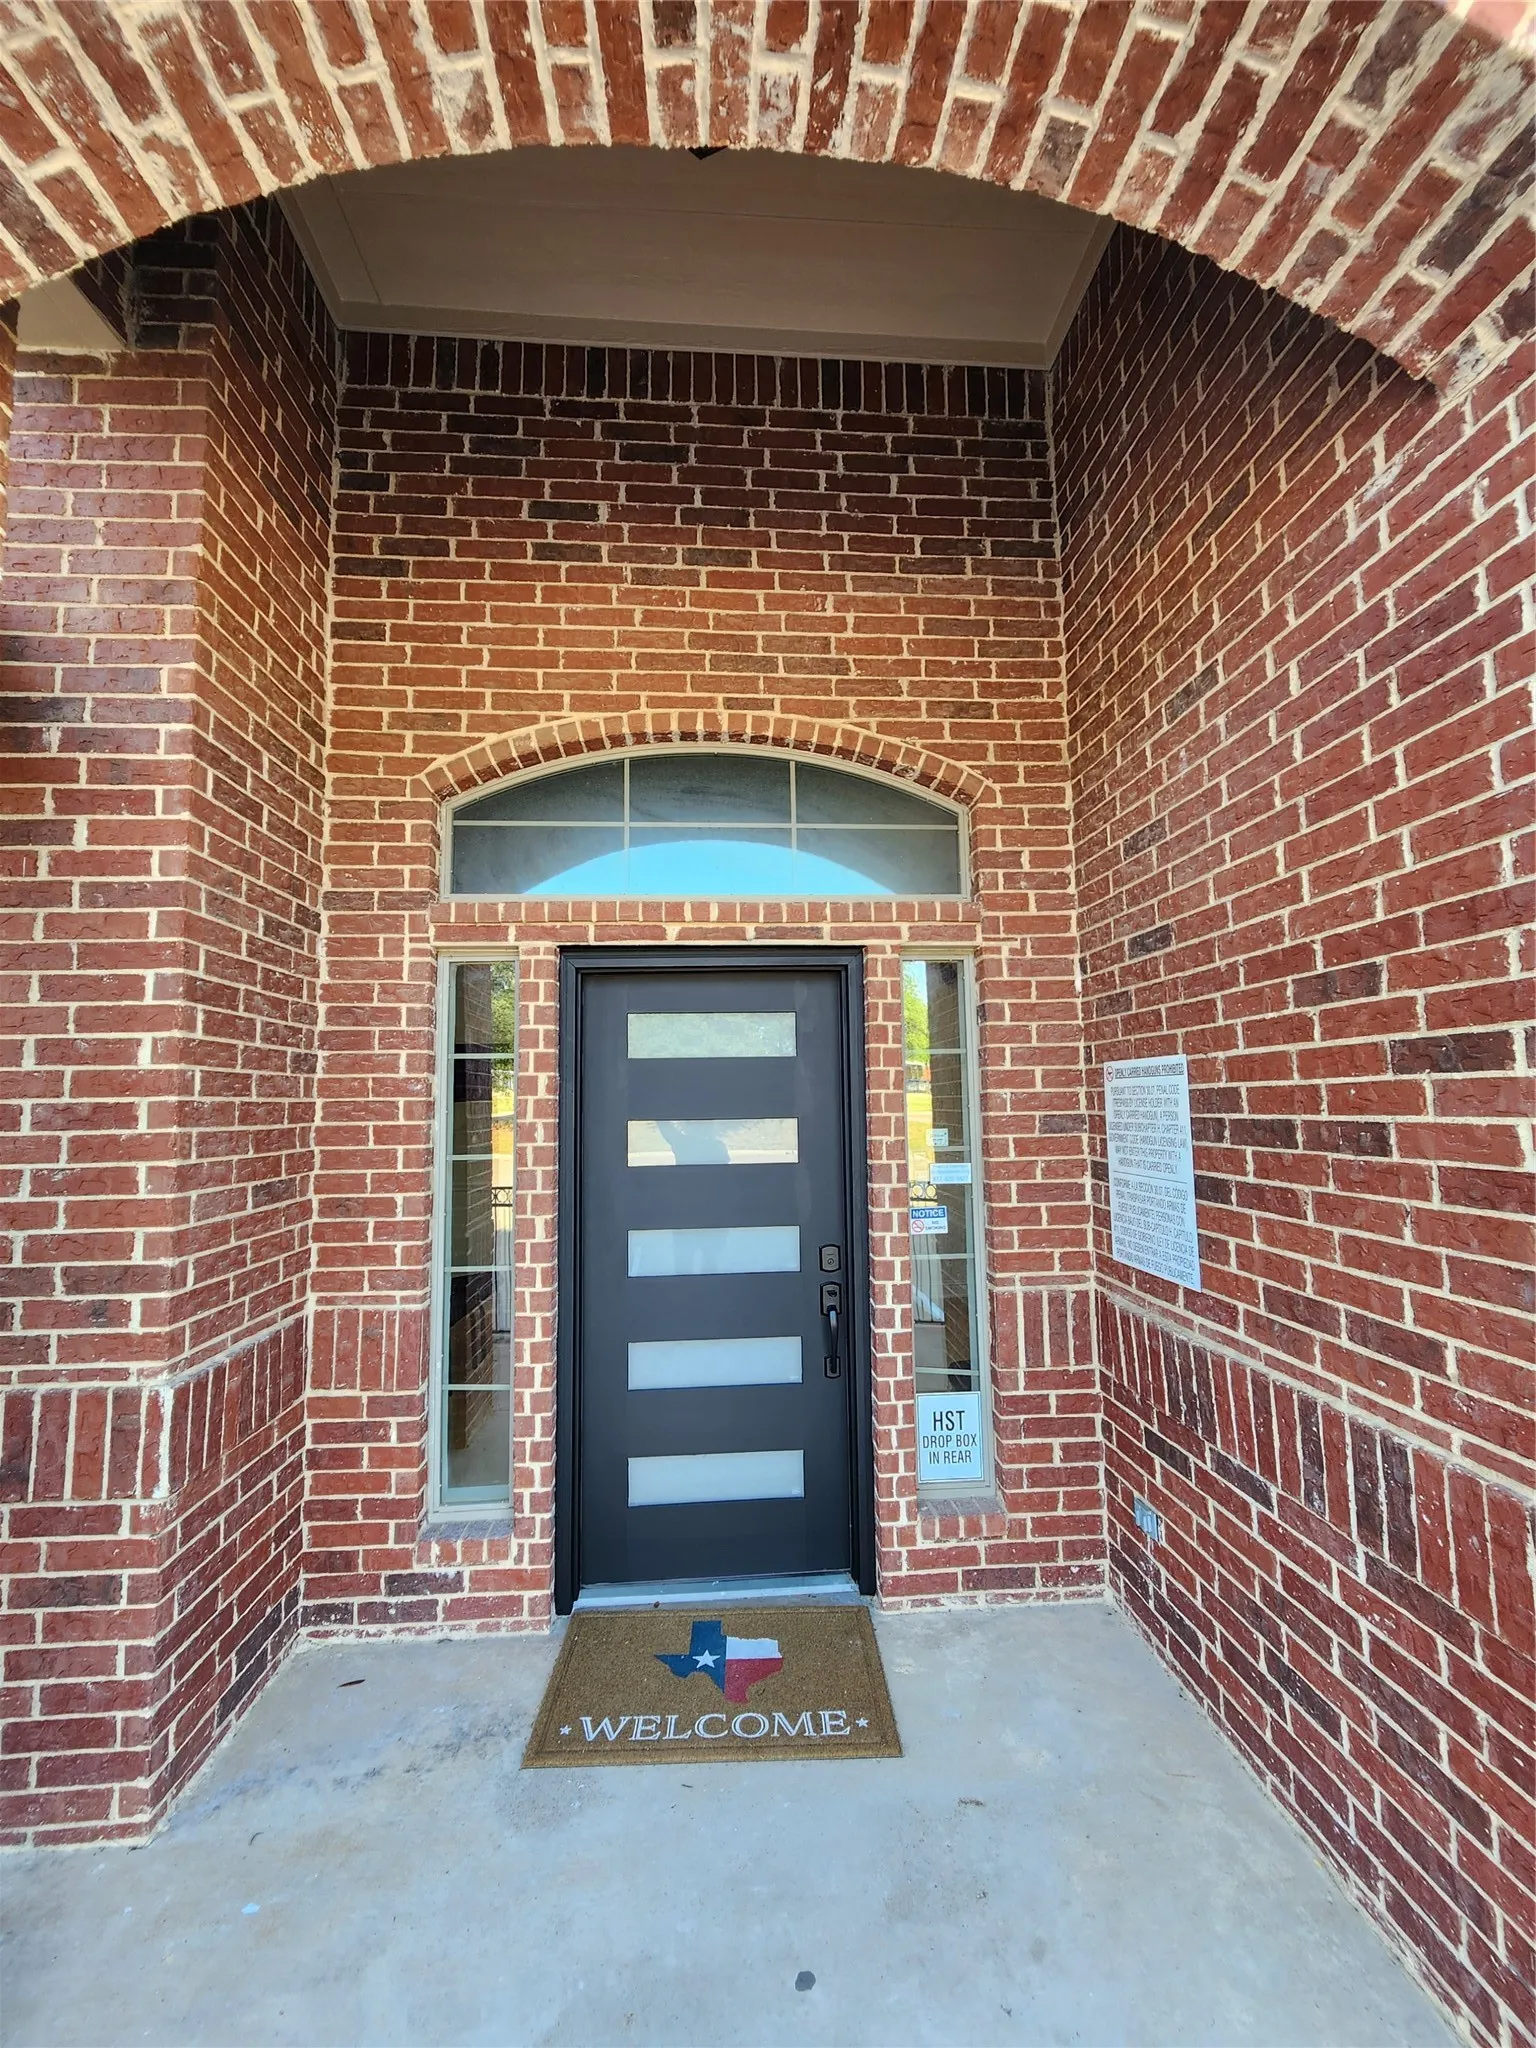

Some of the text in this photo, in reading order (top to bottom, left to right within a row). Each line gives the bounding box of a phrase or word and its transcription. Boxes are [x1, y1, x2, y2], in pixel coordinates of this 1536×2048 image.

[913, 1209, 944, 1217] NOTICE
[933, 1410, 965, 1431] HST
[922, 1433, 977, 1448] DROP BOX
[929, 1450, 972, 1465] IN REAR
[579, 1710, 852, 1742] WELCOME
